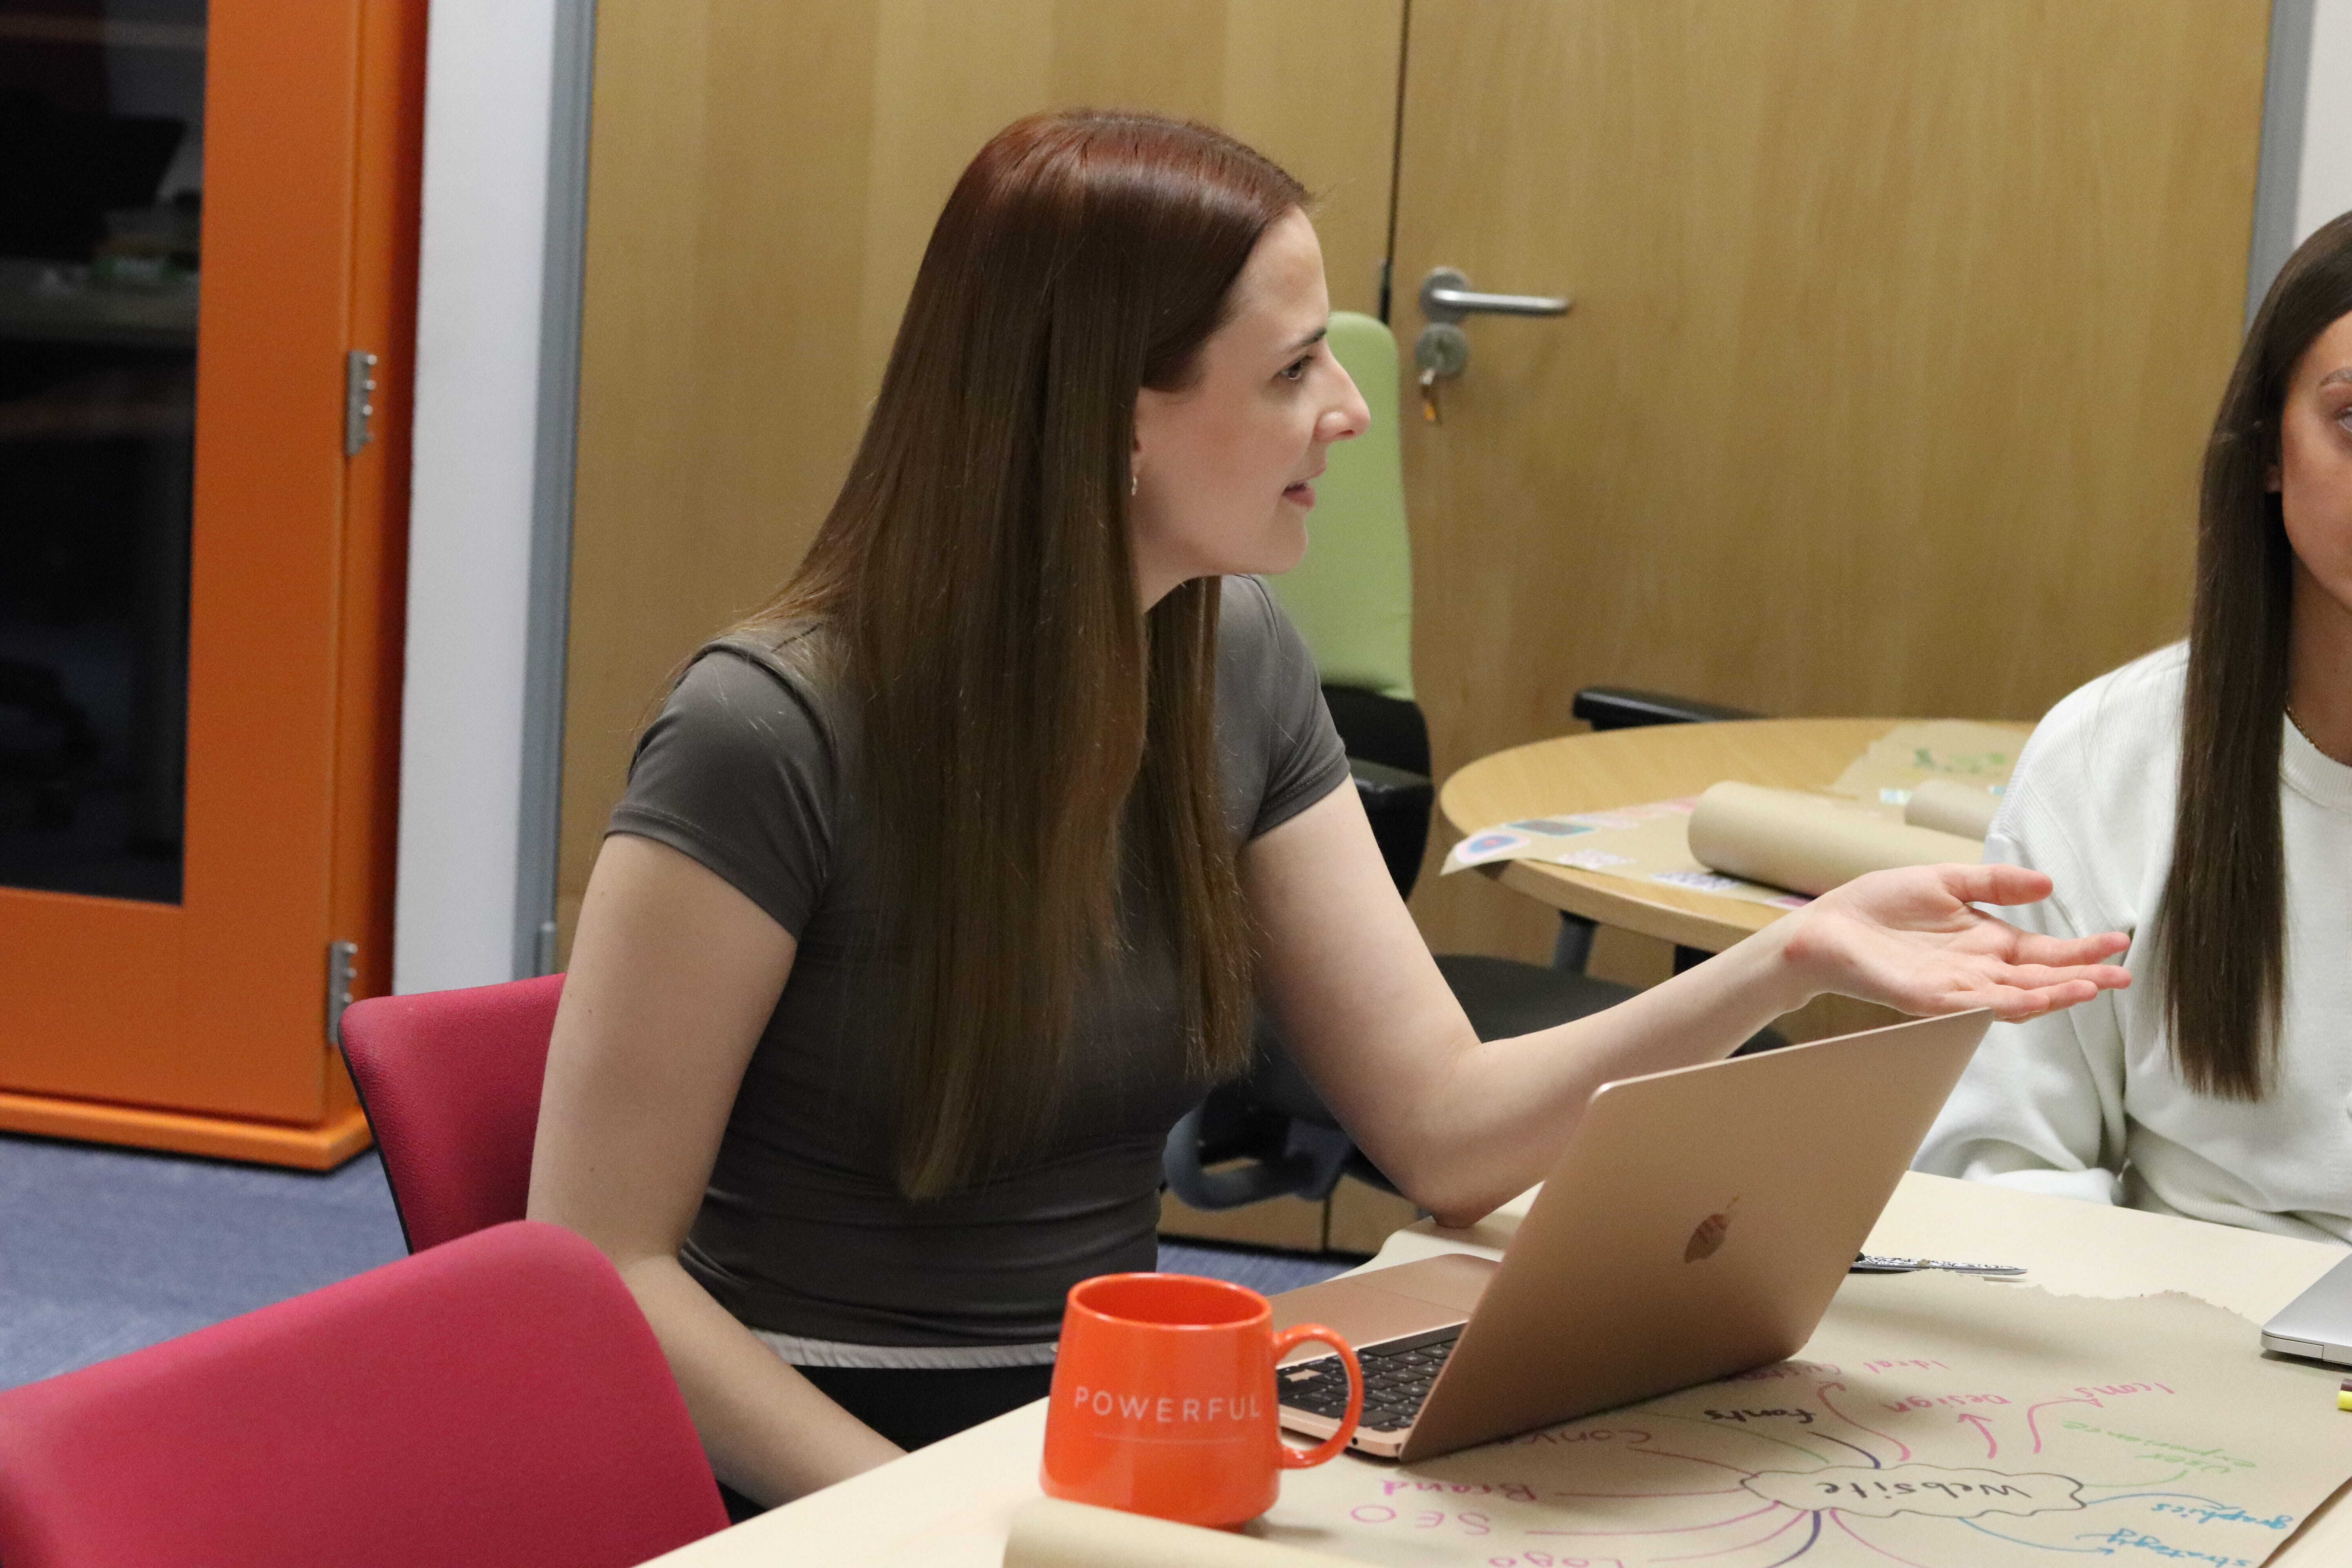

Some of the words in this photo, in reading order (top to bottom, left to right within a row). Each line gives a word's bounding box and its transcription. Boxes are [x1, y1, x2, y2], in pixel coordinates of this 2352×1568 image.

[1074, 1386, 1264, 1423] POWERFUL
[1882, 1394, 2011, 1413] Design
[1383, 1480, 1537, 1502] Brand
[1350, 1504, 1490, 1535] SEO
[2151, 1503, 2294, 1529] graphics
